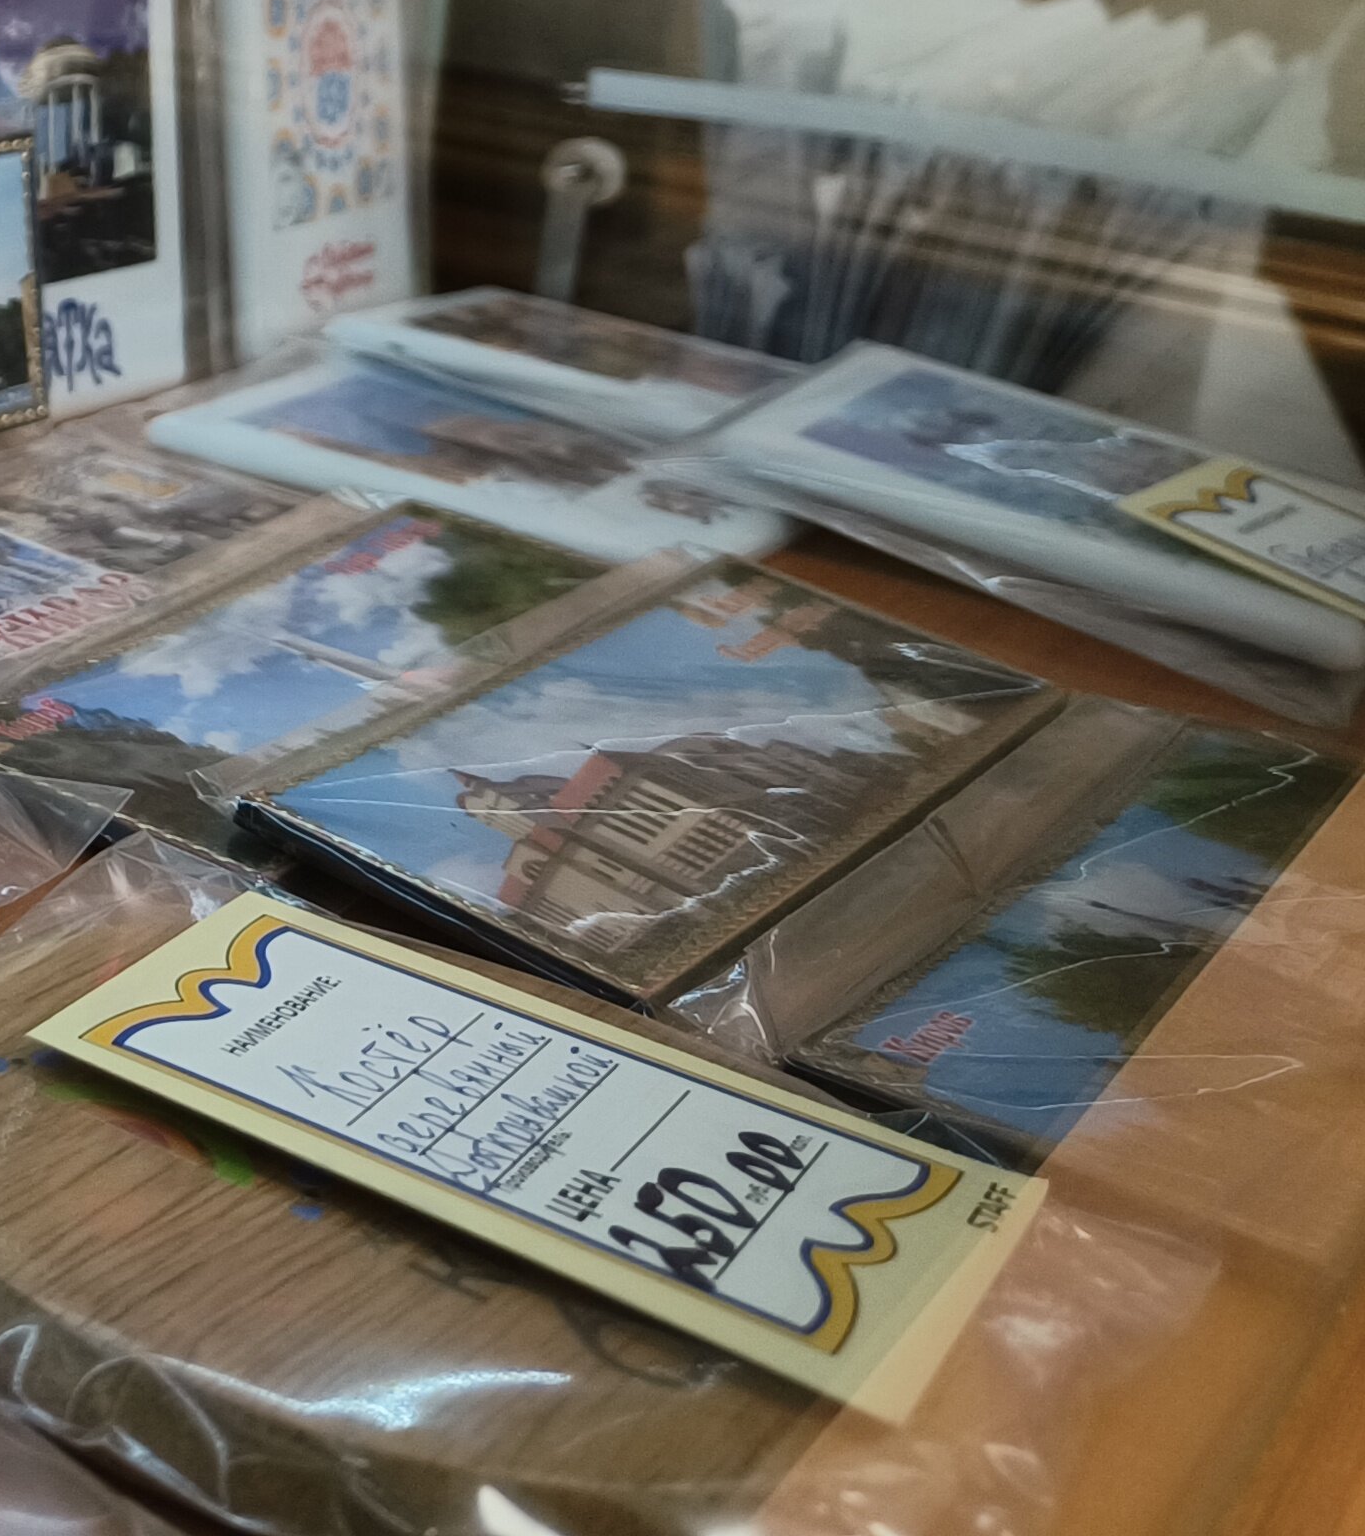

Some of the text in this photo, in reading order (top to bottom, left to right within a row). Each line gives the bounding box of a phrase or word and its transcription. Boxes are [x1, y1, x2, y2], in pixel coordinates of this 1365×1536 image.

[220, 975, 342, 1057] НАИМЕНОВАНИЕ:
[725, 1131, 804, 1193] 00
[545, 1168, 622, 1223] ЦЕНА
[966, 1181, 1017, 1233] STAFF
